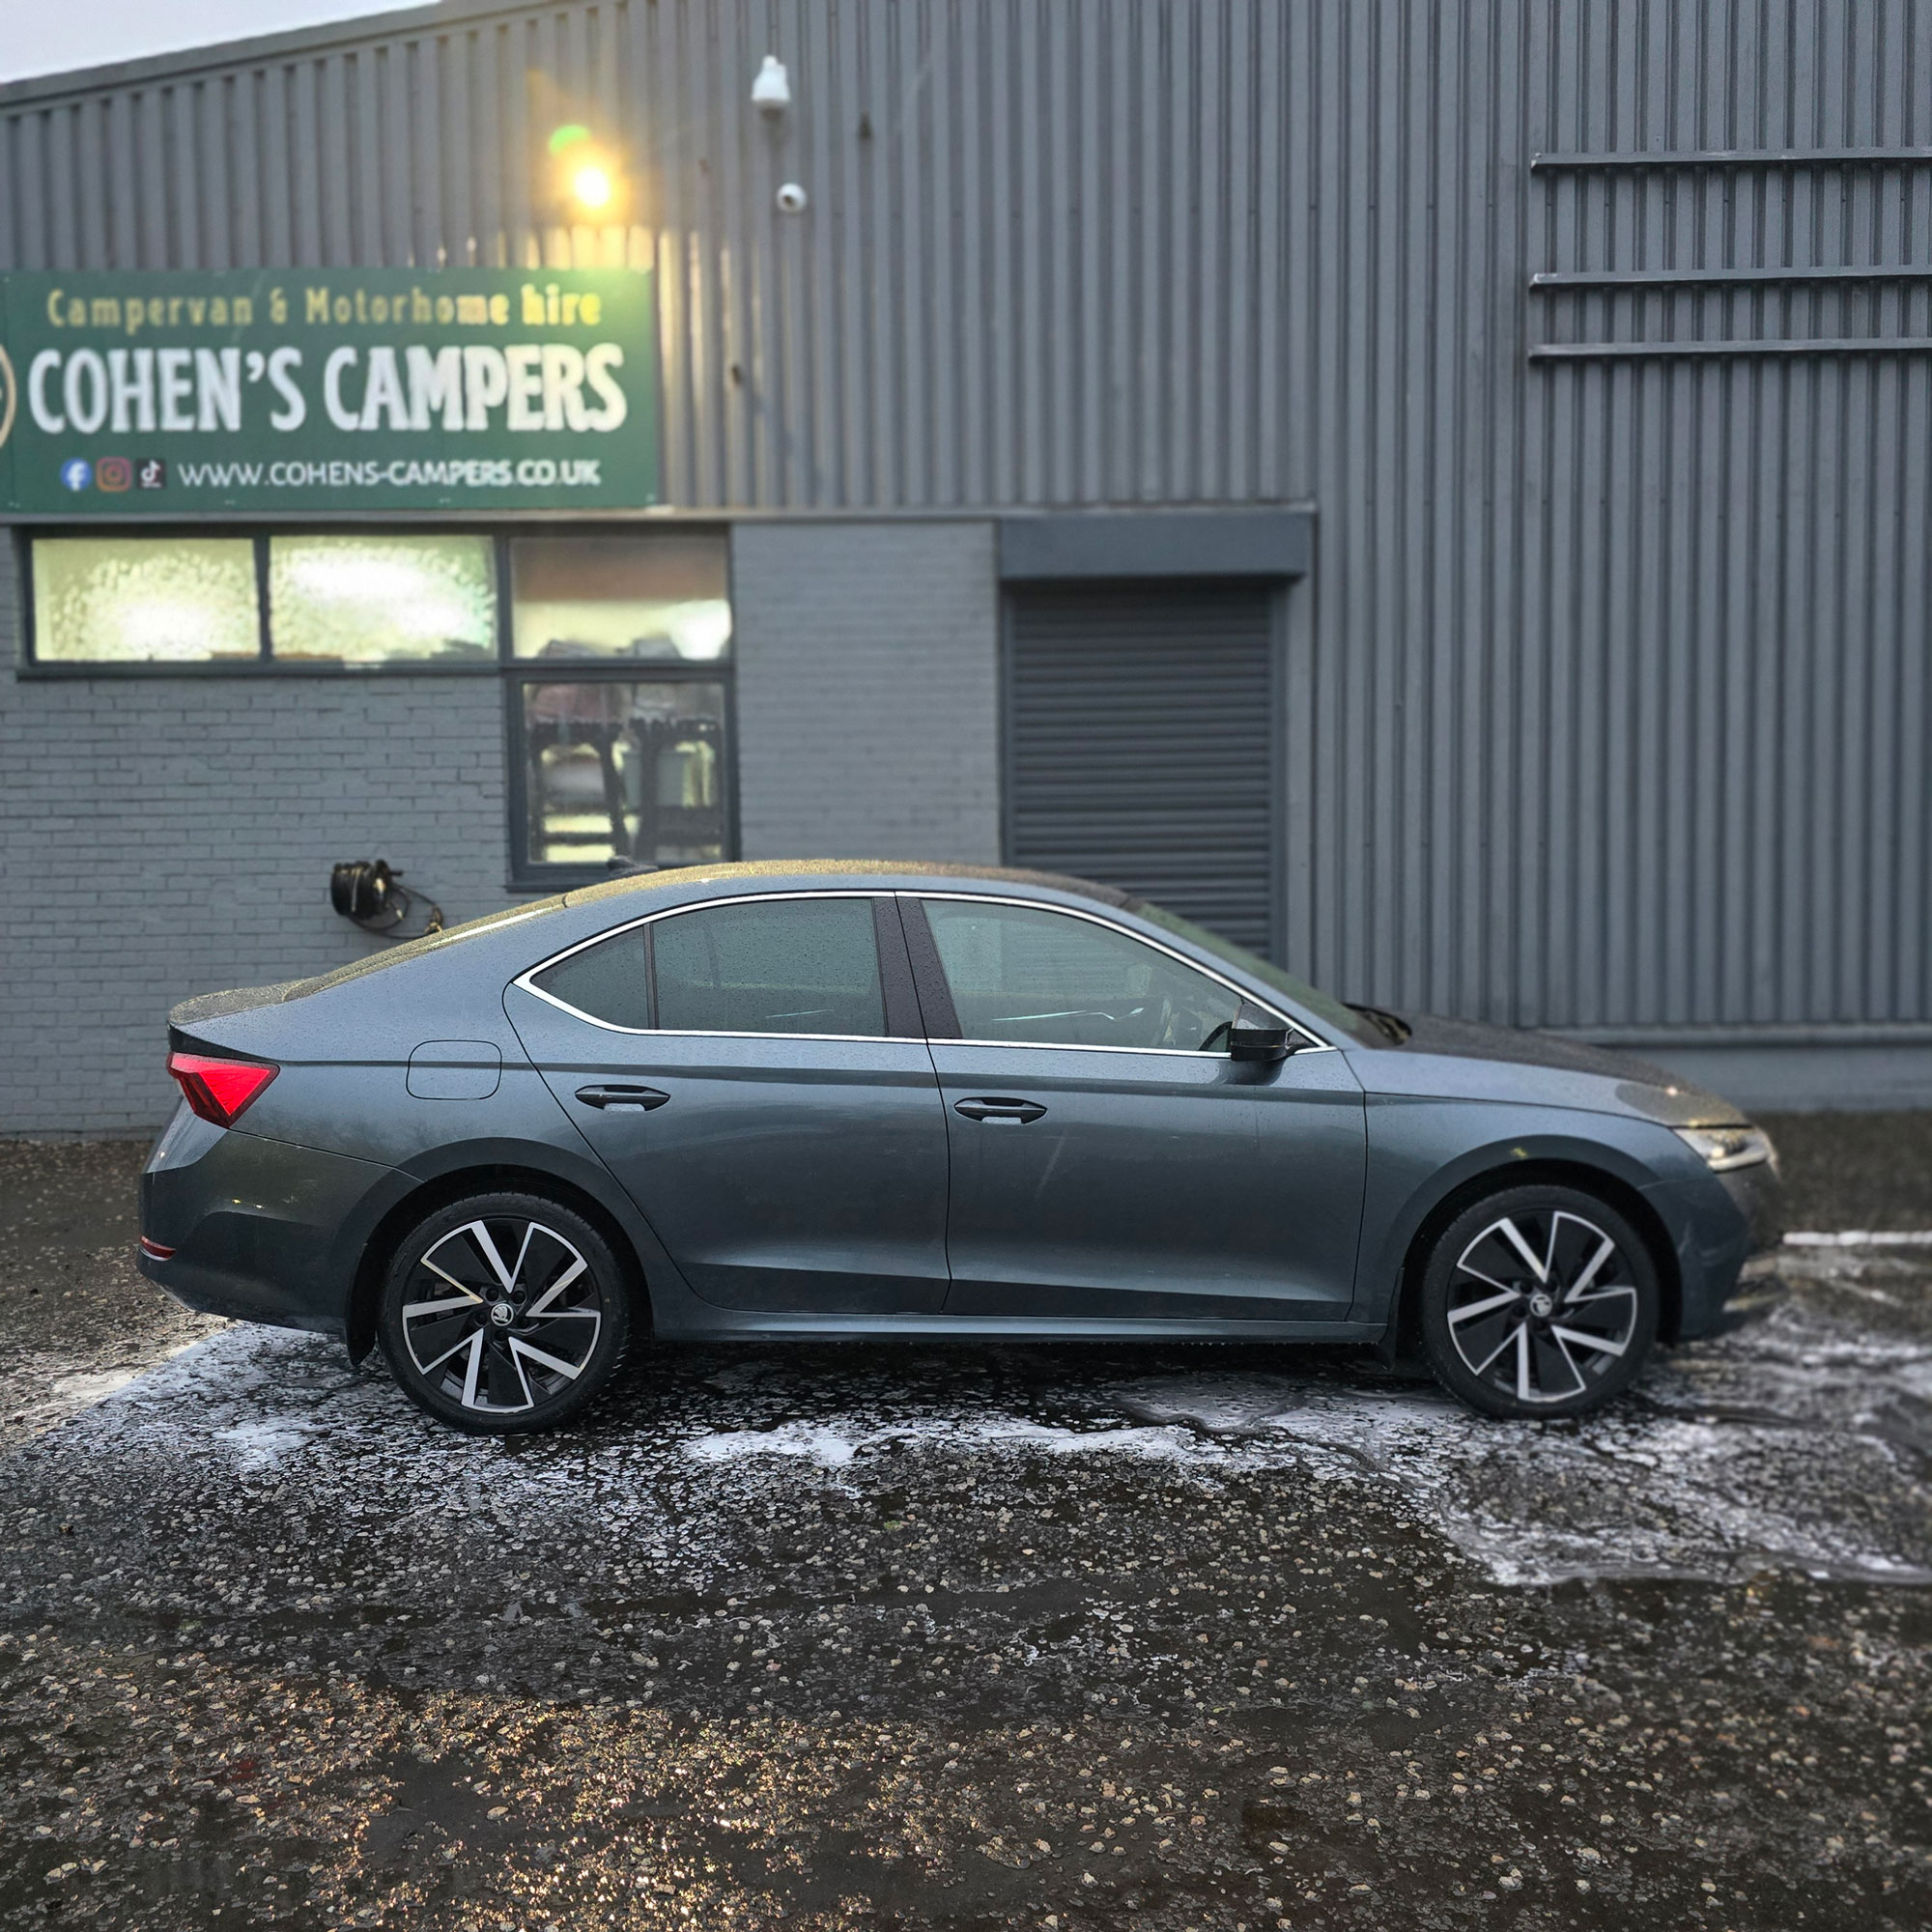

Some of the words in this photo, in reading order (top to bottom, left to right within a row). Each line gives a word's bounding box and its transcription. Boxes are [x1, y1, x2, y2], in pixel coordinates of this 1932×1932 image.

[47, 289, 253, 334] Campervan
[270, 288, 288, 324] &
[306, 288, 509, 325] Motorhome
[522, 284, 602, 325] hire
[324, 343, 627, 432] CAMPERS
[178, 460, 601, 487] WWW.COHENS-CAMPERS.CO.UK
